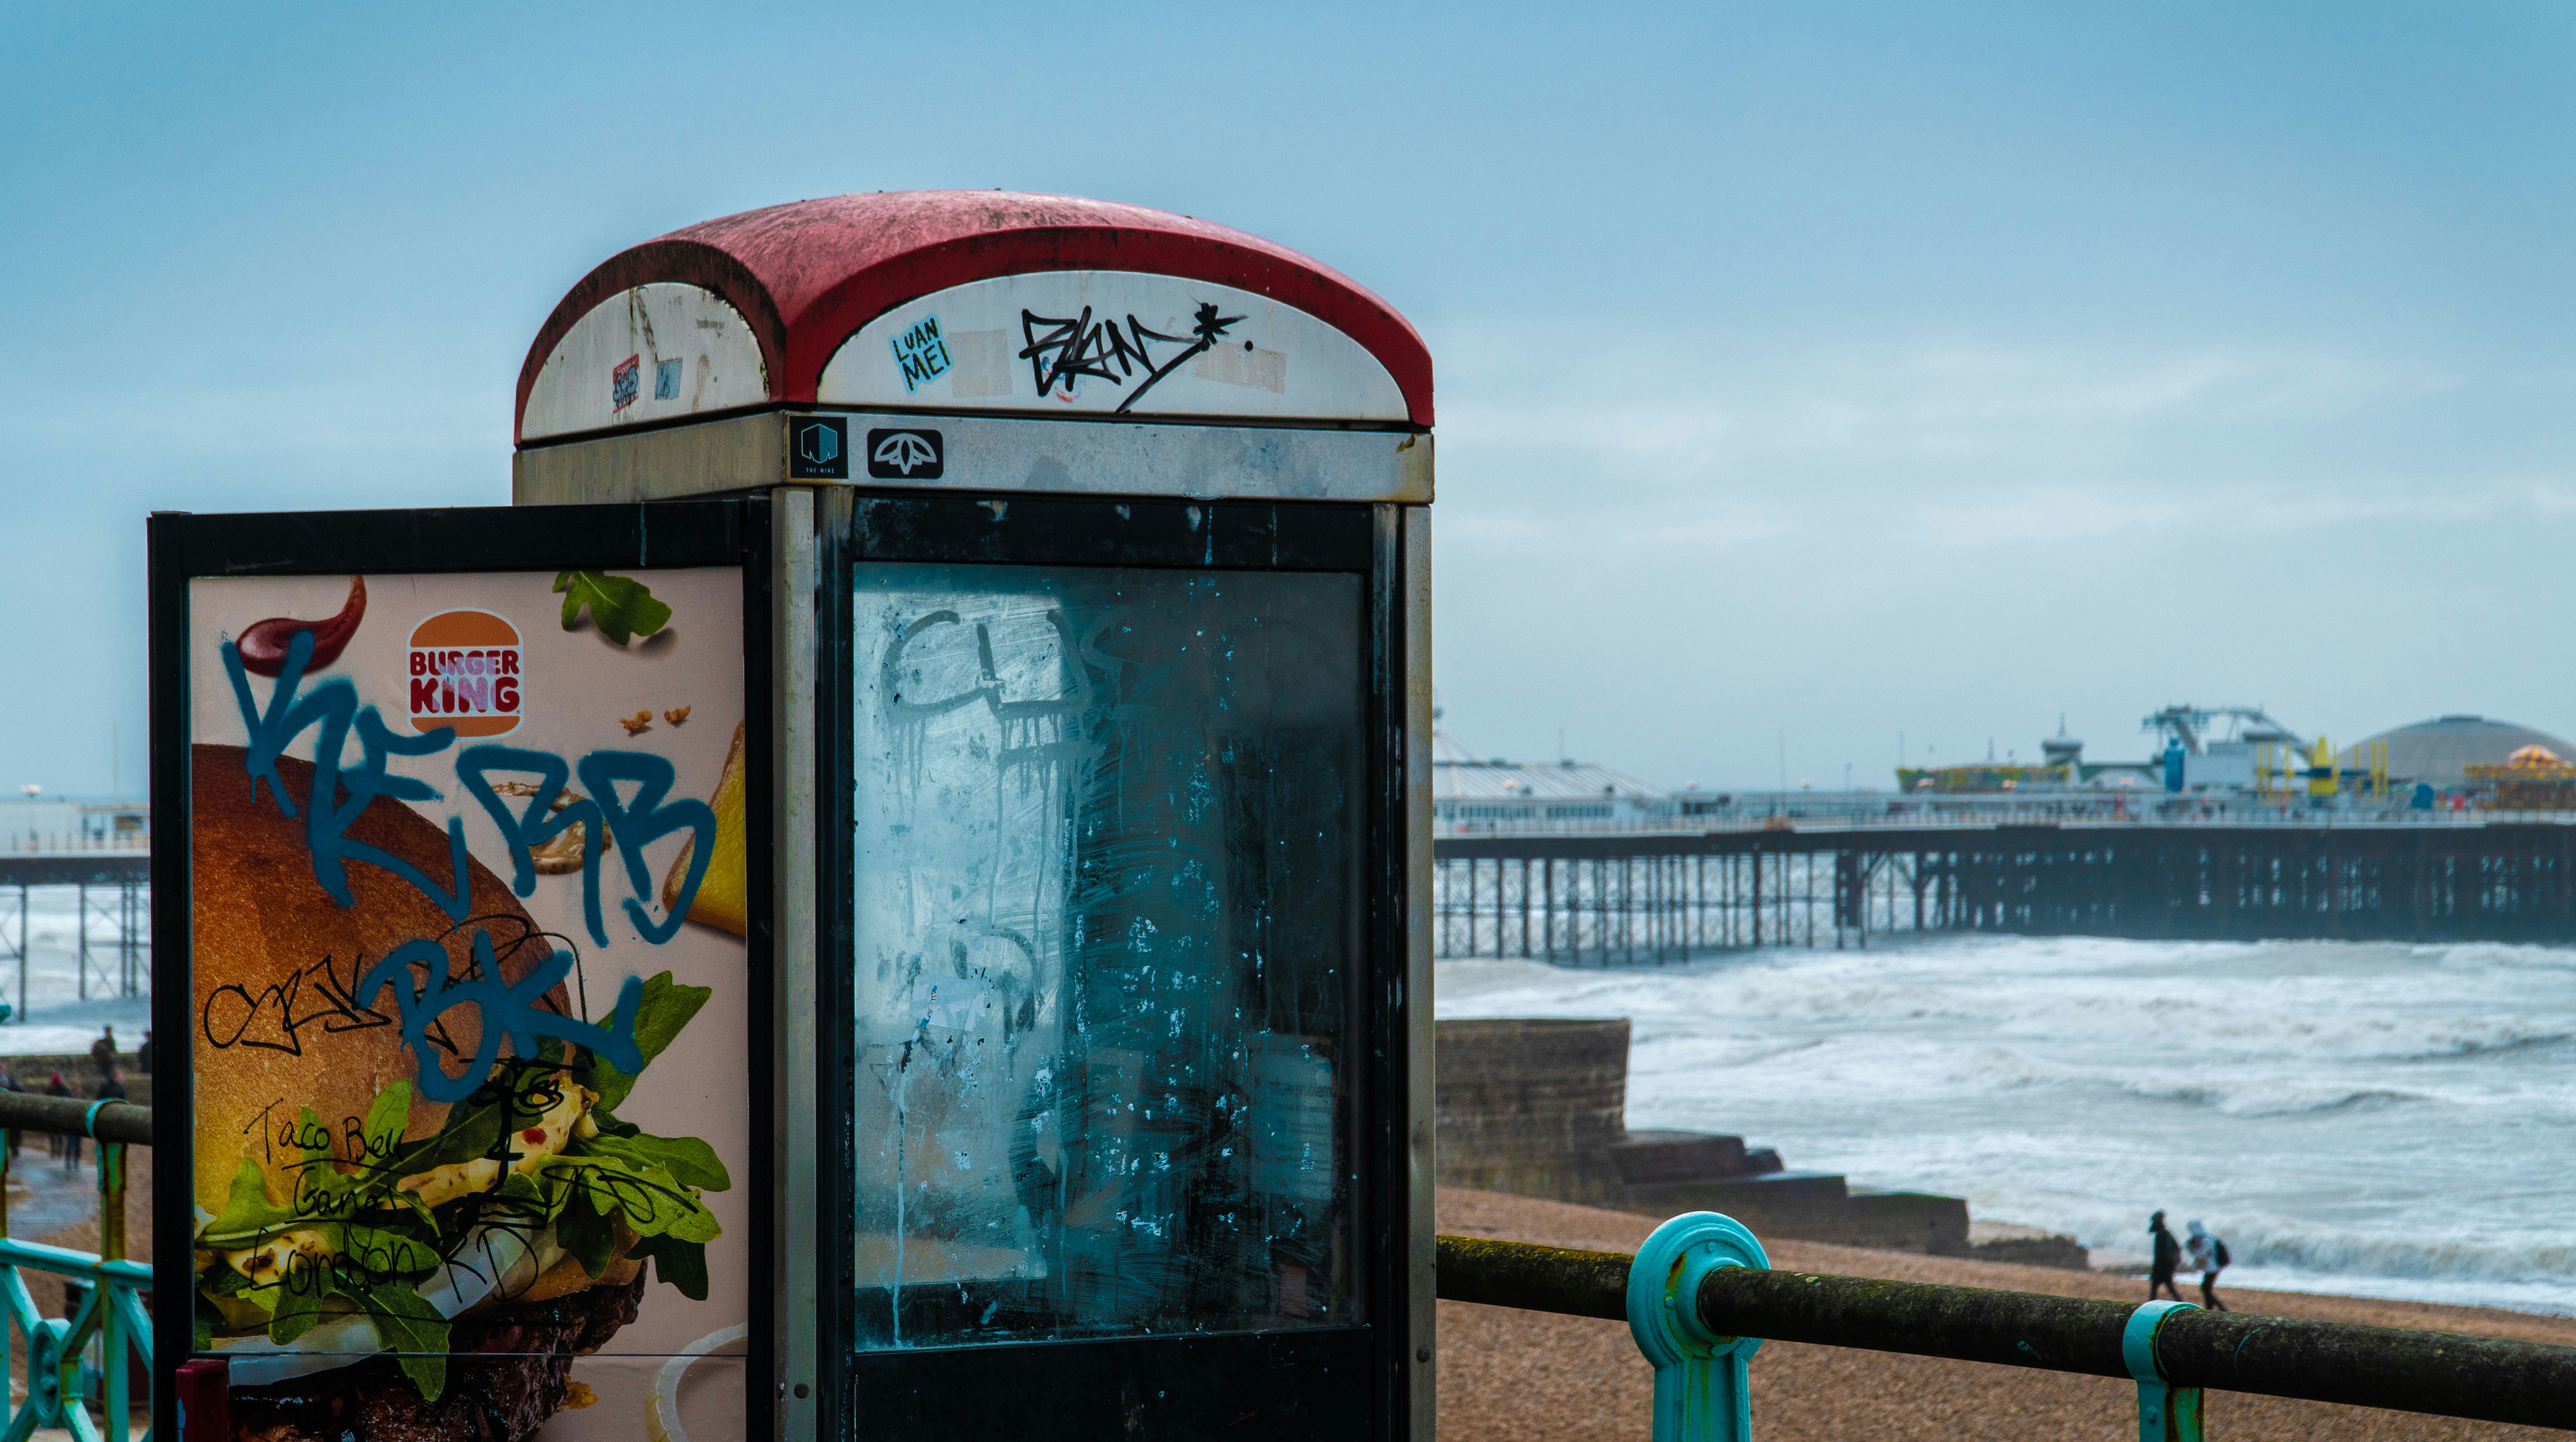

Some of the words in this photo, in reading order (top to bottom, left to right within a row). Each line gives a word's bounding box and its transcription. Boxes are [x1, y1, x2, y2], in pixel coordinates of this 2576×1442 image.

[893, 318, 939, 362] LUAN
[903, 340, 950, 391] MEI
[410, 650, 519, 676] BURGER
[410, 677, 520, 713] KING
[245, 1098, 329, 1165] Taco
[250, 1227, 418, 1299] London
